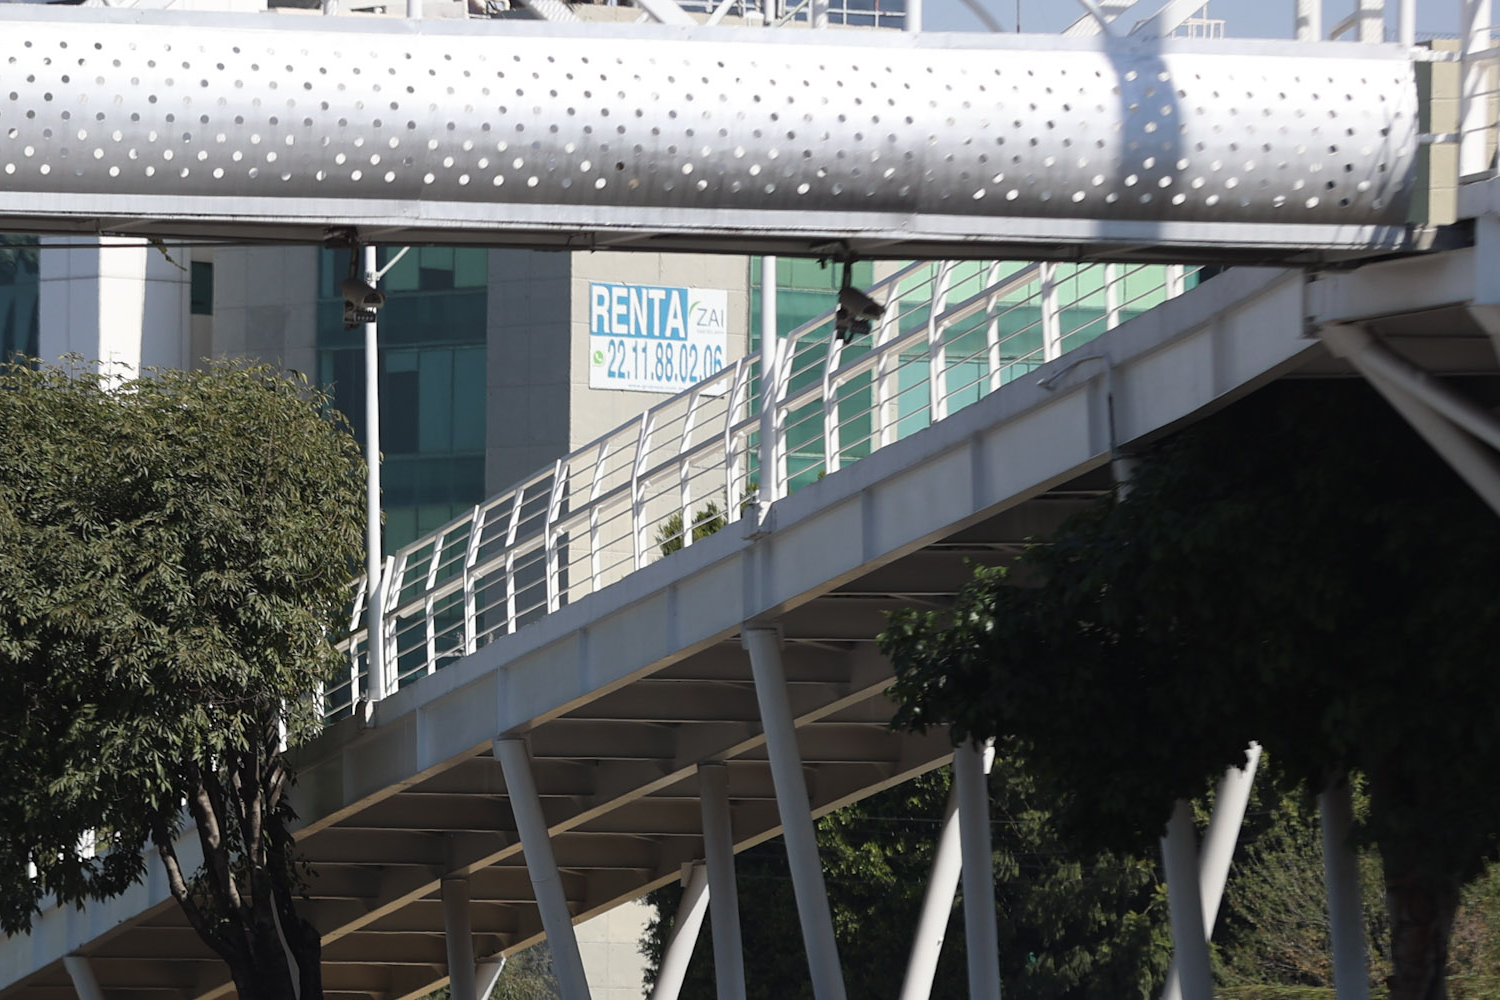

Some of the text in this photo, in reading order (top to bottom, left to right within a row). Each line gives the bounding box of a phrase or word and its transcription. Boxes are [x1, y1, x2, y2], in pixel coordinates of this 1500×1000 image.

[591, 285, 686, 338] RENTA
[696, 308, 723, 327] ZAI
[607, 339, 722, 385] 22.11.88.02.06
